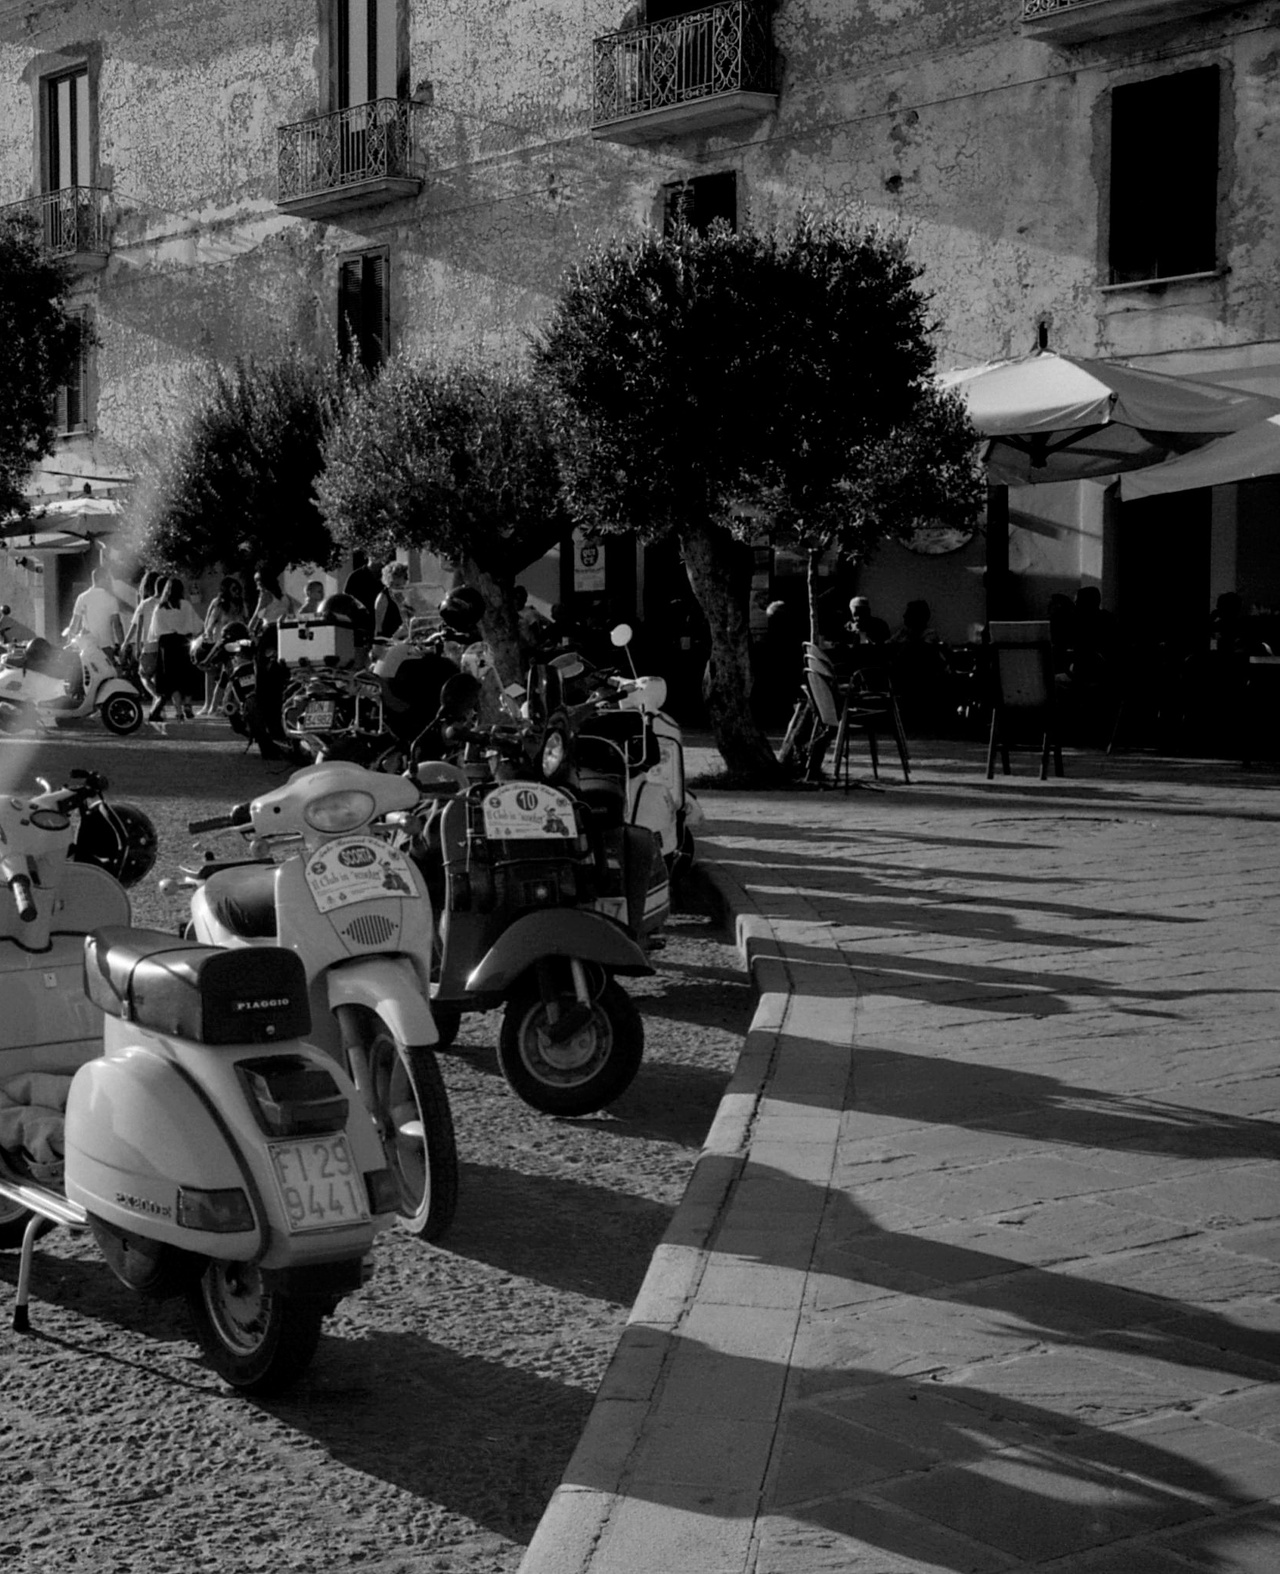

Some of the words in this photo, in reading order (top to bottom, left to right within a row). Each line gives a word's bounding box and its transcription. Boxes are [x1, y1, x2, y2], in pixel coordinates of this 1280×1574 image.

[519, 791, 536, 810] 10
[341, 848, 374, 866] SCORTA
[236, 998, 290, 1011] PIAGGIO
[313, 1140, 352, 1179] 29
[283, 1180, 359, 1220] 9441
